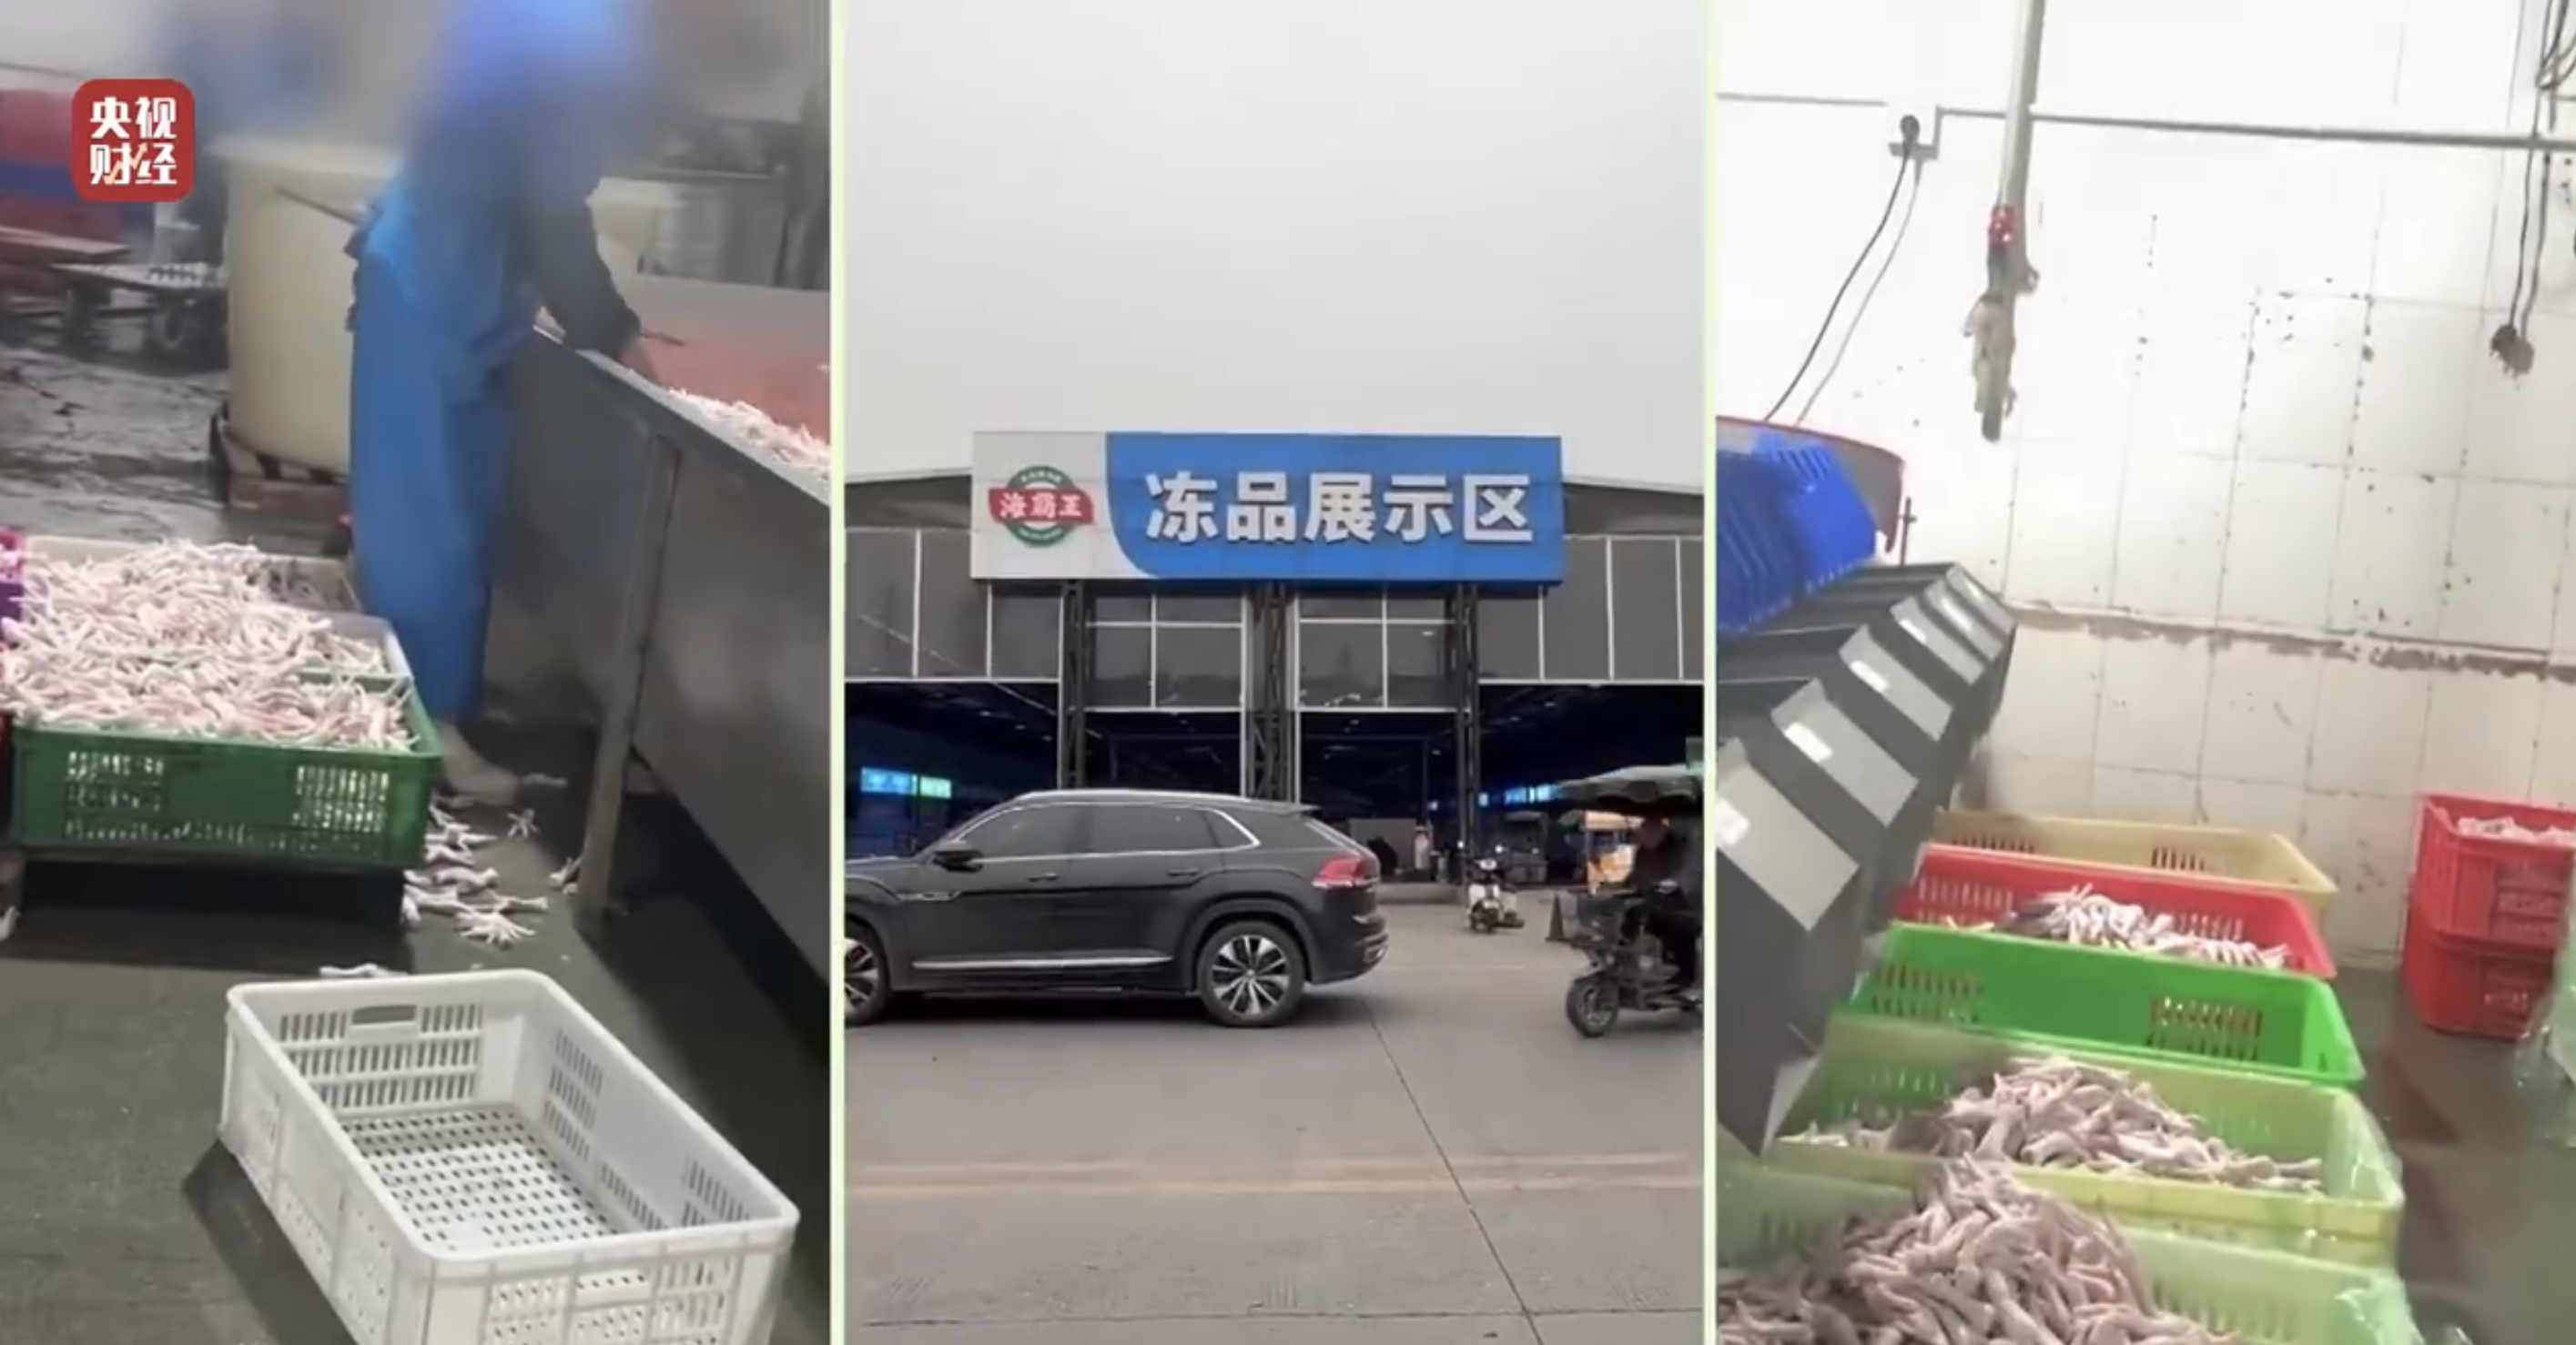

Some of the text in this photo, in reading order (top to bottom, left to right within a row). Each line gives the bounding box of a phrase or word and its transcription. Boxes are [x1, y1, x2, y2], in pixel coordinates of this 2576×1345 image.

[999, 491, 1082, 519] 海霸王
[1145, 471, 1534, 543] 冻品展示区
